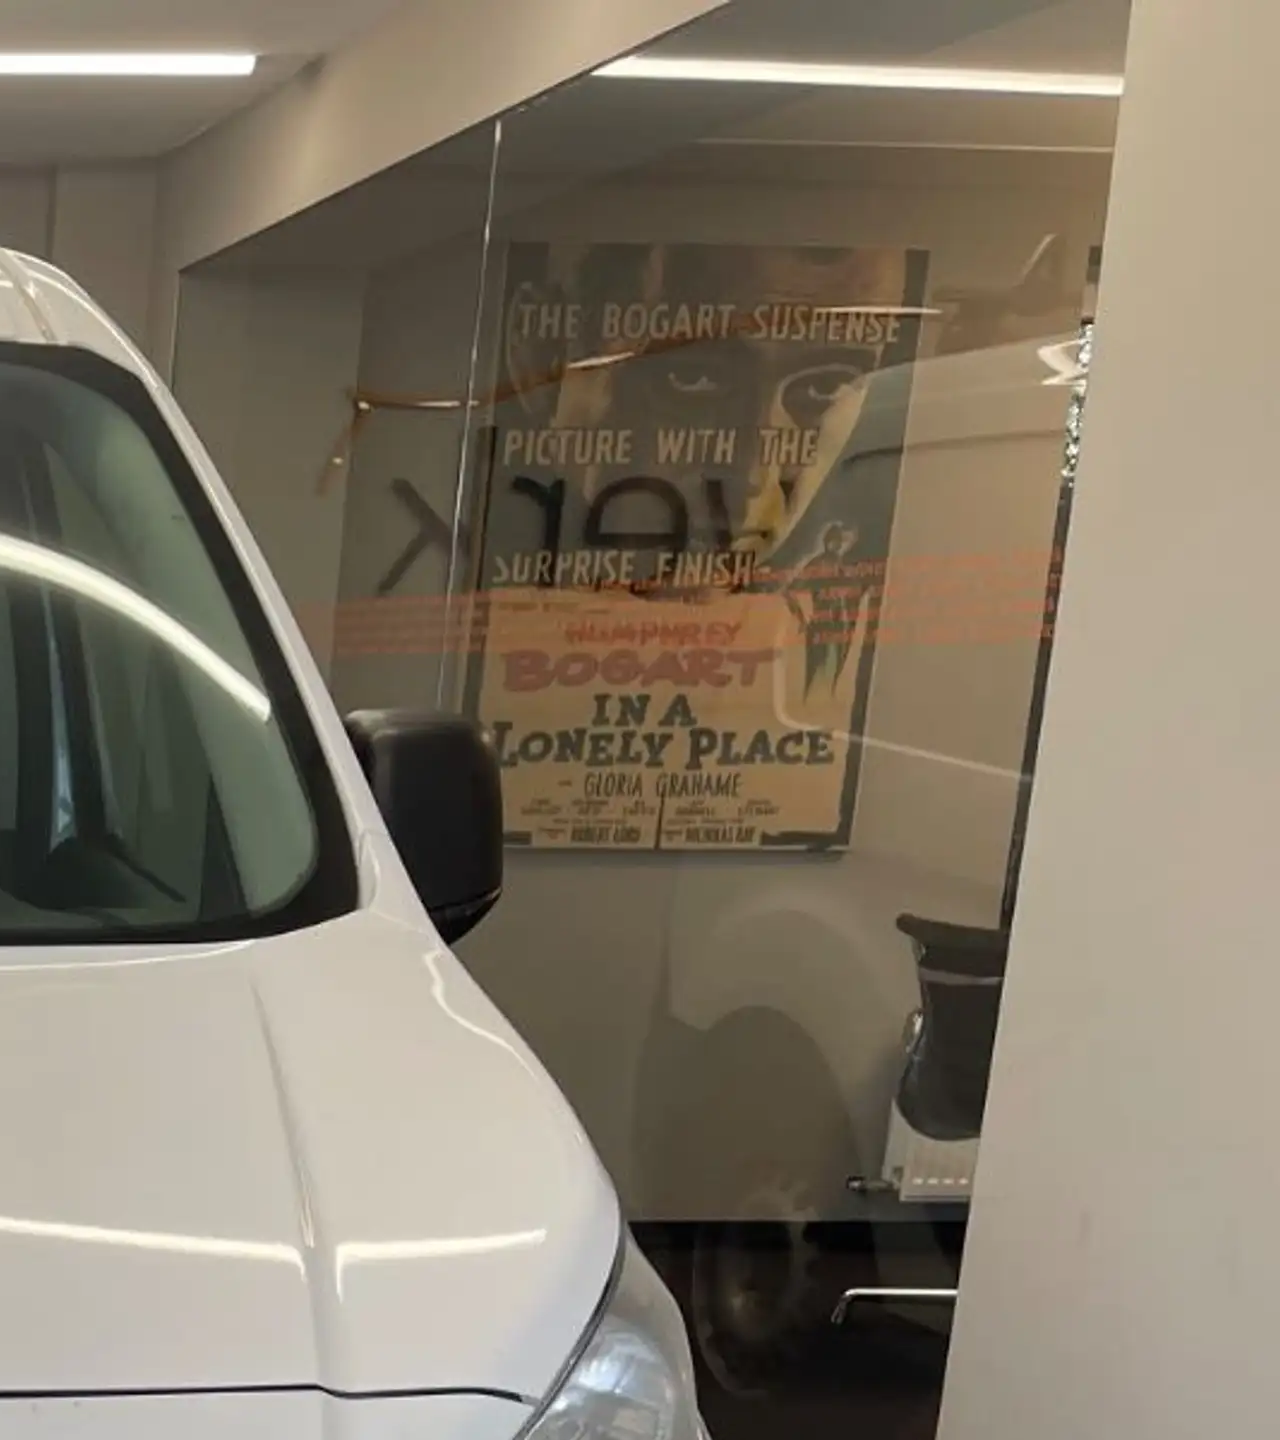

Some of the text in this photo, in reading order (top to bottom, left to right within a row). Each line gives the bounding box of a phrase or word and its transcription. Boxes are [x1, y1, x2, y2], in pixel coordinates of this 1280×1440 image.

[518, 302, 902, 344] THE BOGART SUSPENSE
[502, 427, 821, 467] PICTURE WITH THE
[502, 646, 778, 693] BOGART
[591, 693, 698, 728] IN A
[491, 720, 836, 771] LONELY PLACE
[583, 770, 743, 799] GLORIA GRAHAME
